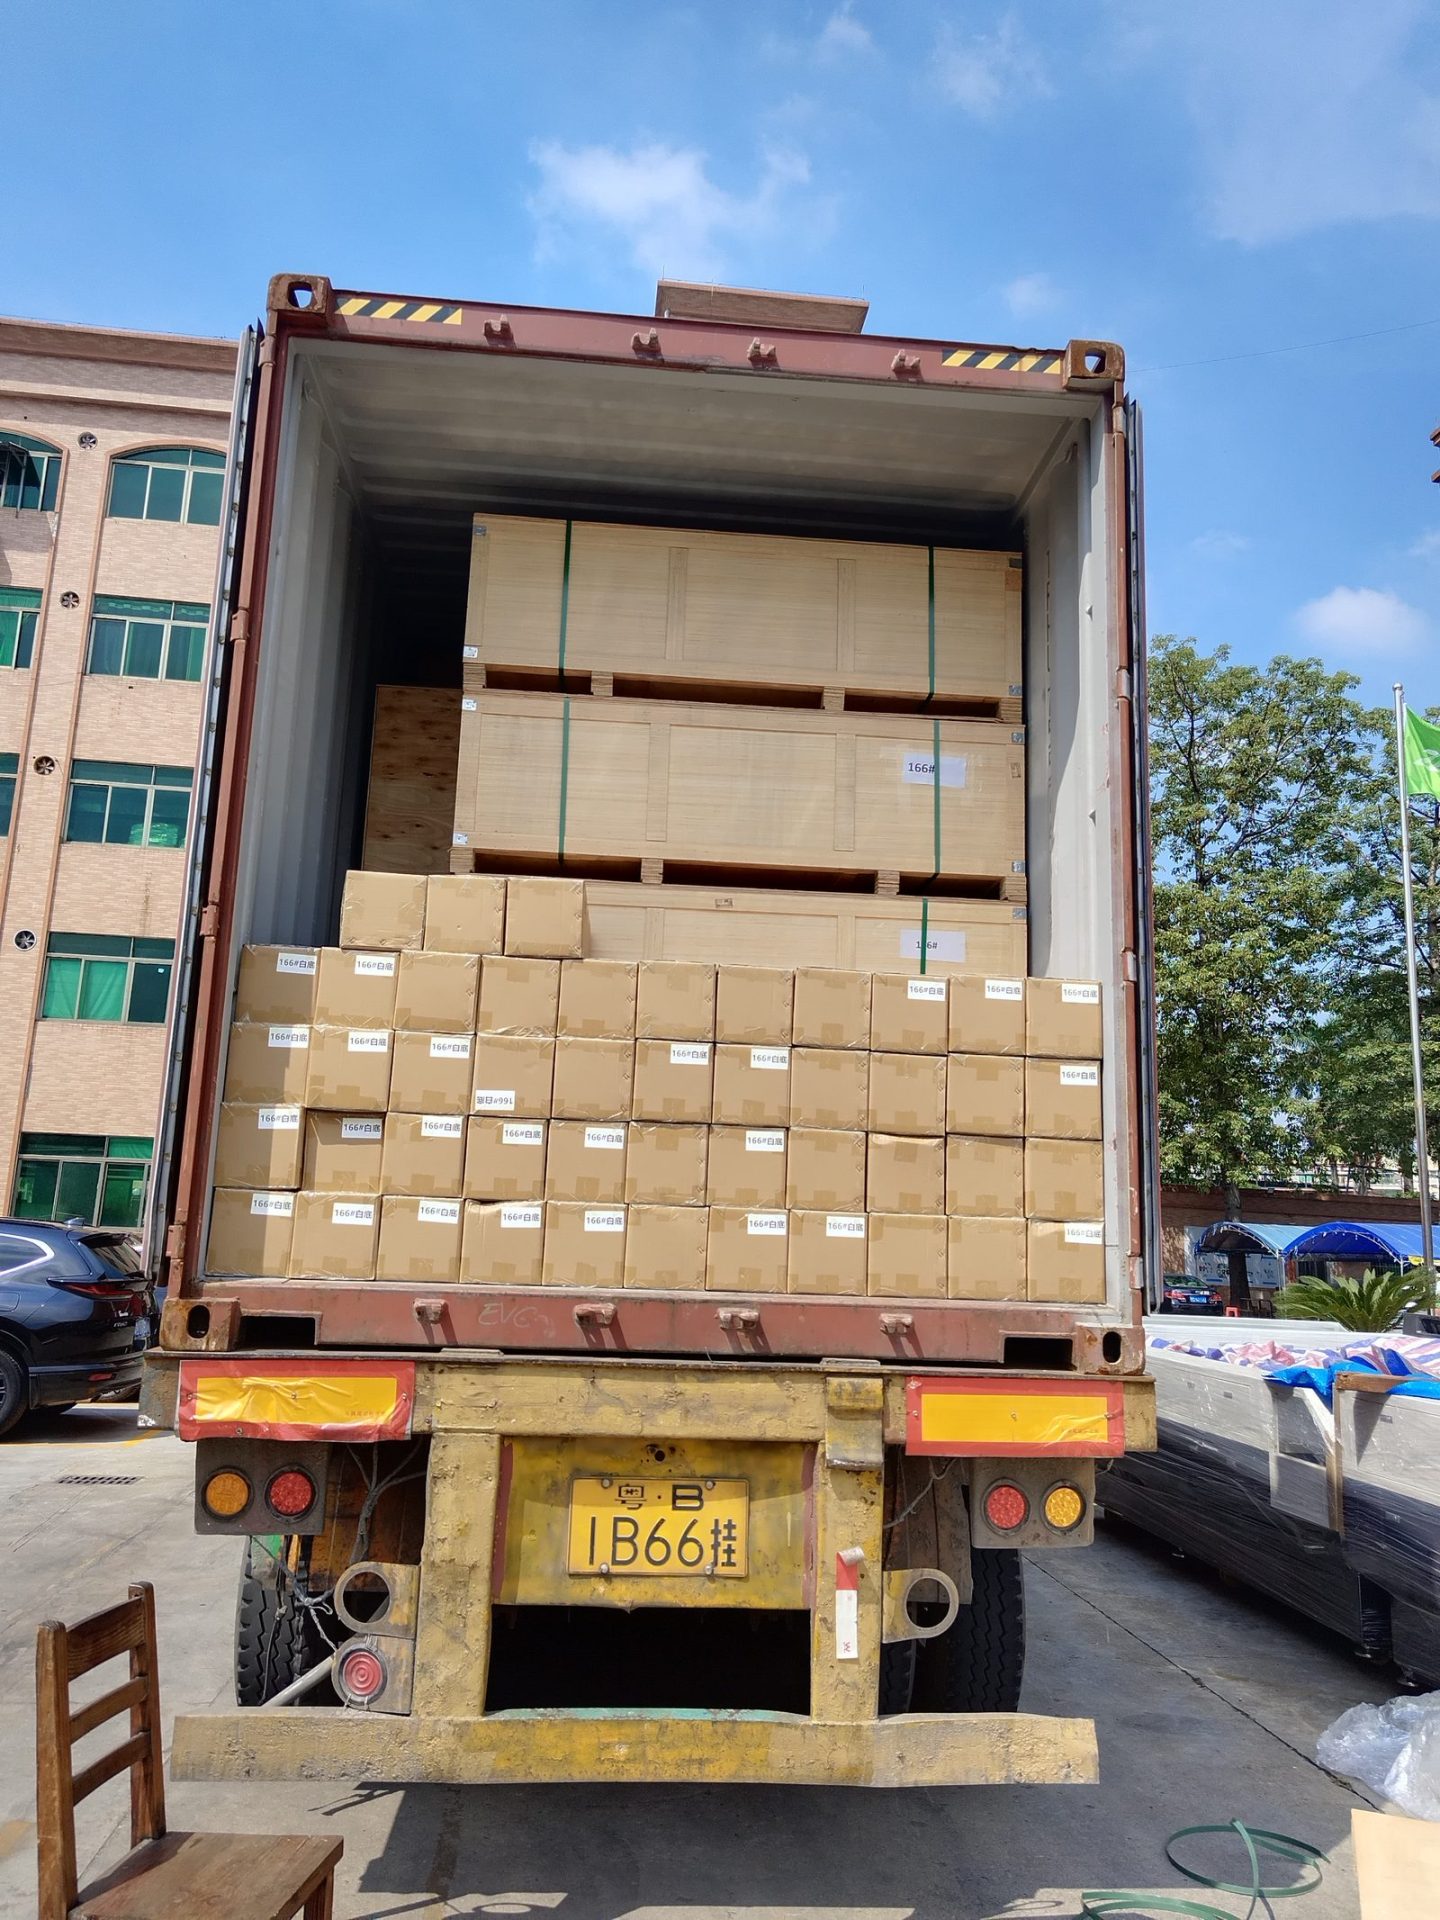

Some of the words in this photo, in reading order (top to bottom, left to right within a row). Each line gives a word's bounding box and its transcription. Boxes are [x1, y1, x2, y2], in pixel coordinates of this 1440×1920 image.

[908, 762, 935, 773] 166#
[916, 941, 938, 949] 16#
[279, 959, 315, 969] 166#白底
[357, 961, 393, 971] 166#白底
[910, 986, 944, 995] 166#白底
[987, 985, 1020, 995] 166#白底
[1063, 989, 1098, 998] 166#白底
[270, 1033, 308, 1041] 166#白底
[350, 1037, 386, 1046] 166#白底
[432, 1043, 468, 1053] 166#白底
[673, 1049, 707, 1059] 166#白底
[752, 1054, 787, 1064] 166#白底
[1062, 1071, 1096, 1080] 166#白底
[260, 1114, 298, 1123] 166#白底
[344, 1123, 381, 1132] 166#白底
[424, 1121, 461, 1132] 166#白底
[505, 1129, 541, 1139] 166#白底
[587, 1133, 623, 1143] 166#白底
[747, 1136, 783, 1146] 166#白底
[253, 1199, 292, 1210] 166#白底
[335, 1209, 373, 1219] 166#白底
[420, 1206, 458, 1217] 166#白底
[503, 1213, 540, 1222] 166#白底
[586, 1216, 623, 1226] 166#白底
[749, 1219, 785, 1230] 166#白底
[828, 1221, 864, 1232] 166#白底
